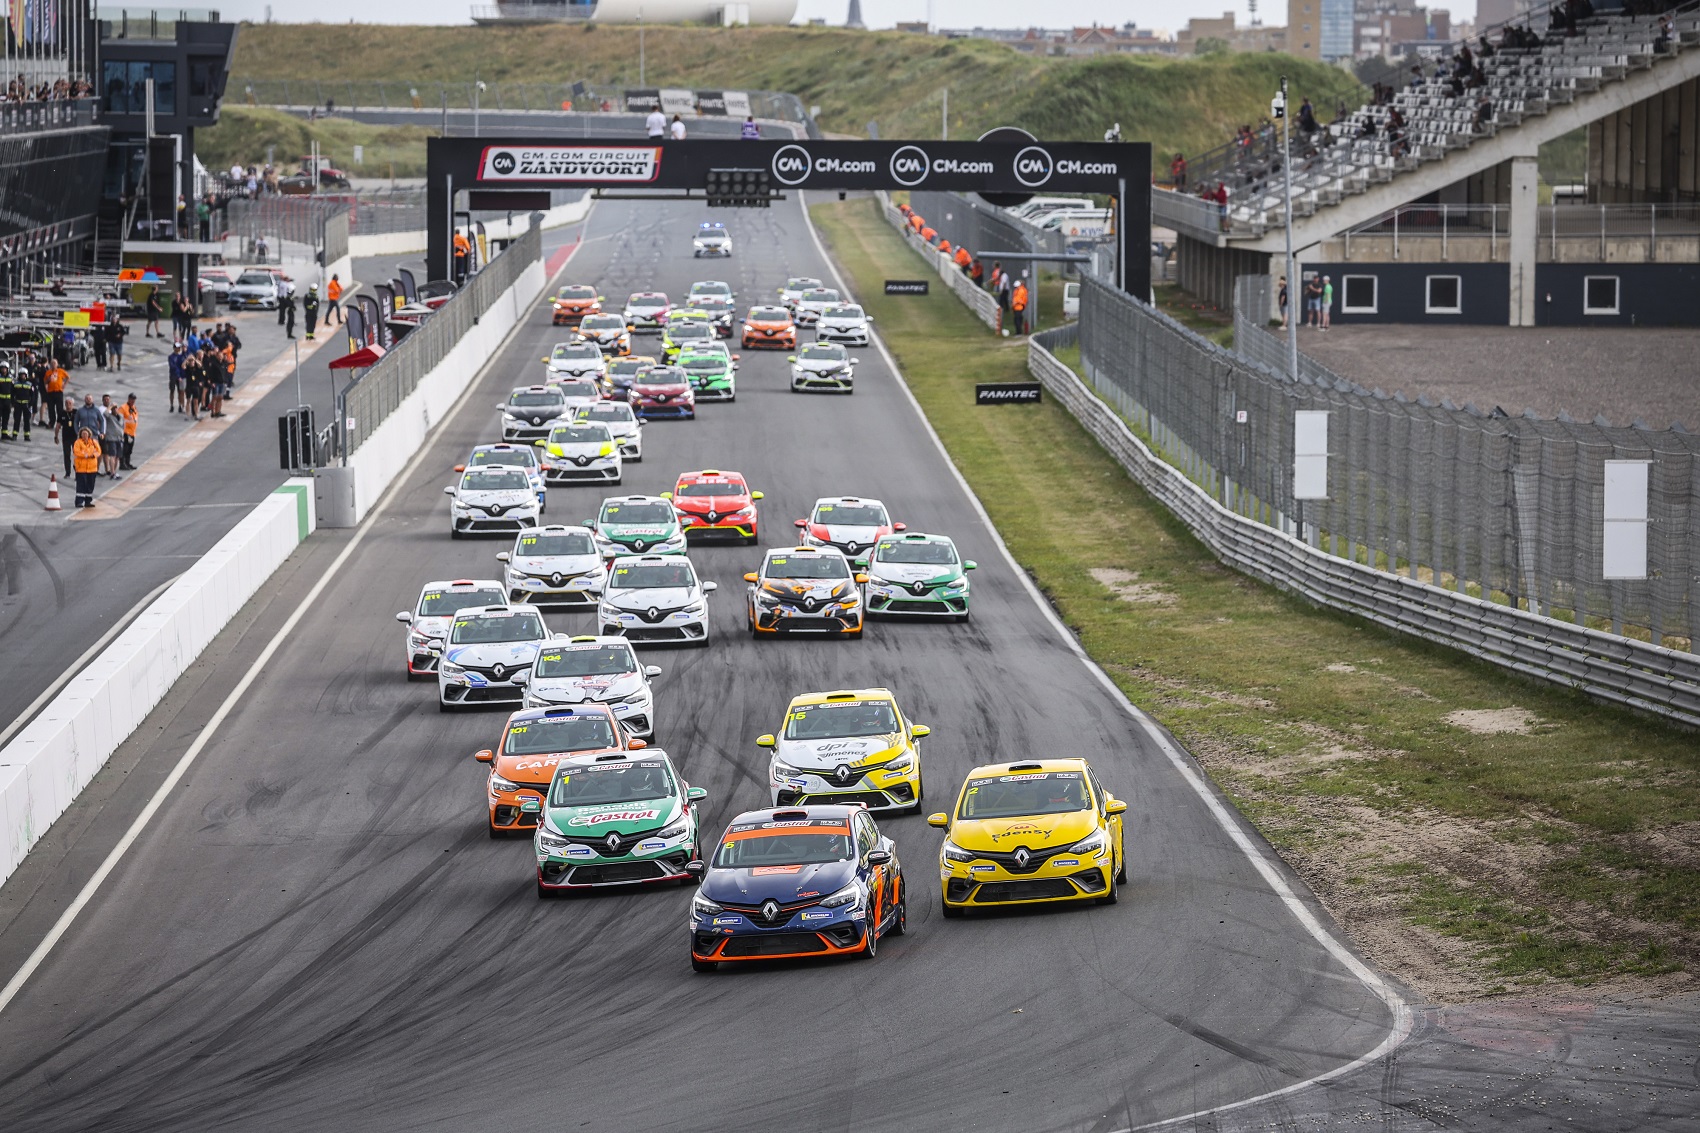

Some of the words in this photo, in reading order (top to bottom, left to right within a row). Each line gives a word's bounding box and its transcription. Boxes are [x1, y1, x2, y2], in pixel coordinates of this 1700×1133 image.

[520, 162, 648, 175] ZANDVOORT
[815, 158, 876, 173] CM.com
[932, 159, 994, 174] CM.com
[1056, 160, 1117, 175] CM.com
[886, 284, 926, 292] FANATEC
[979, 390, 1039, 399] FANATEC
[1239, 412, 1245, 420] F
[788, 711, 807, 721] 15
[510, 727, 528, 735] 101
[599, 763, 632, 771] Castrol
[562, 775, 570, 785] 1
[969, 787, 979, 795] 2
[591, 810, 654, 824] Castrol
[725, 841, 735, 849] 5
